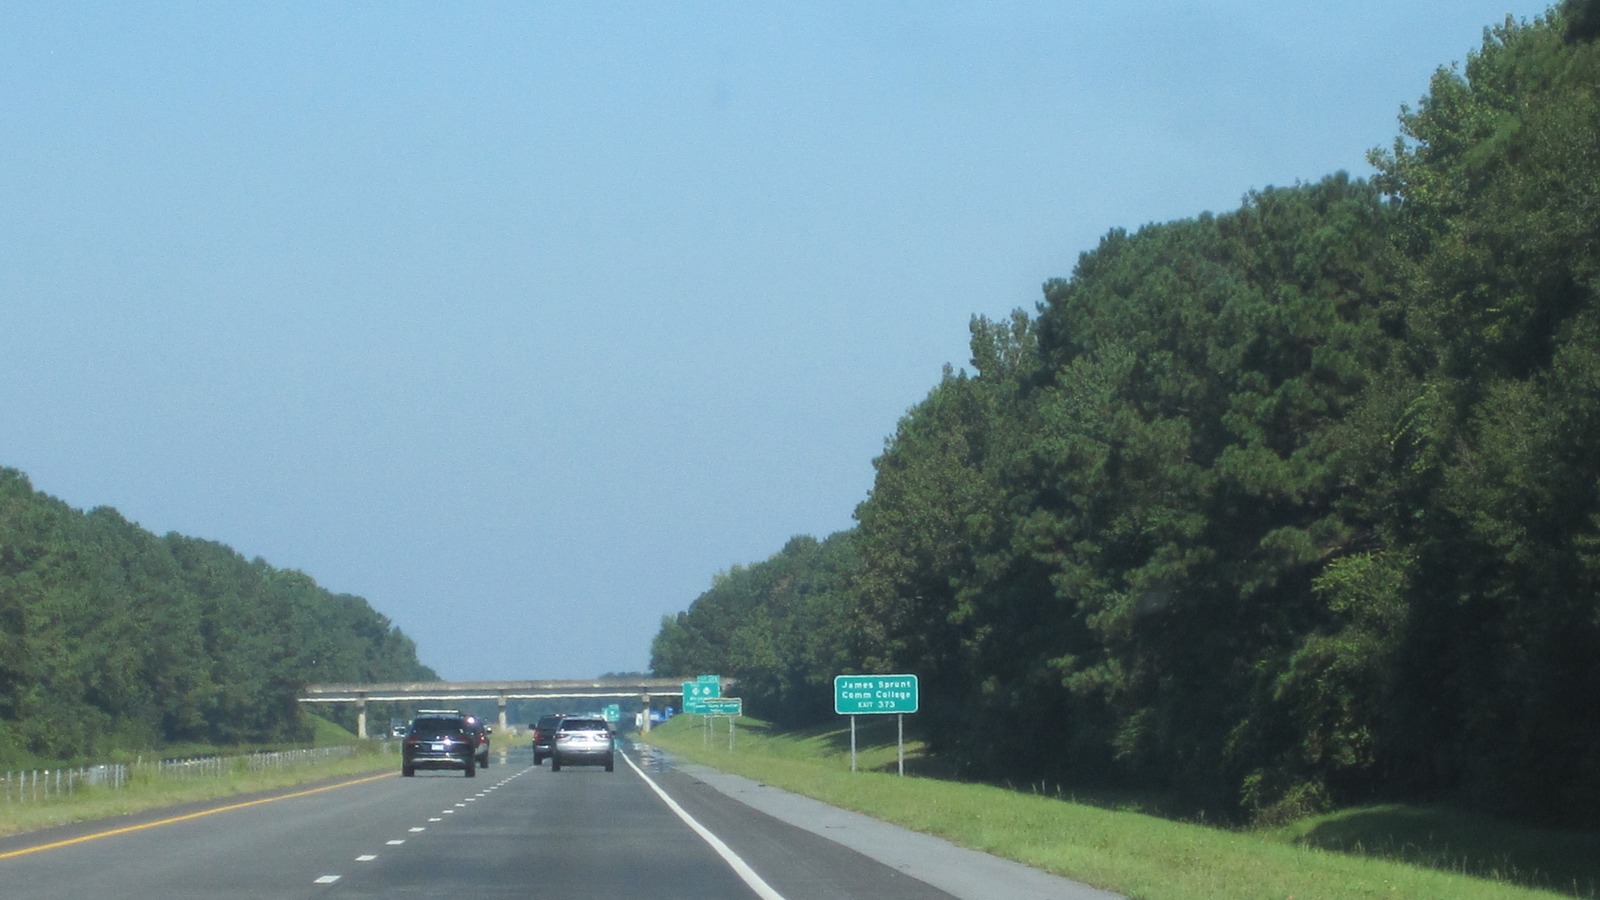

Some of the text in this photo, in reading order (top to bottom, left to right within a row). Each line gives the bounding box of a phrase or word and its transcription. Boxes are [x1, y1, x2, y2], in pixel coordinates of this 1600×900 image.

[842, 680, 911, 689] James Sprunt
[842, 690, 911, 700] Comm College
